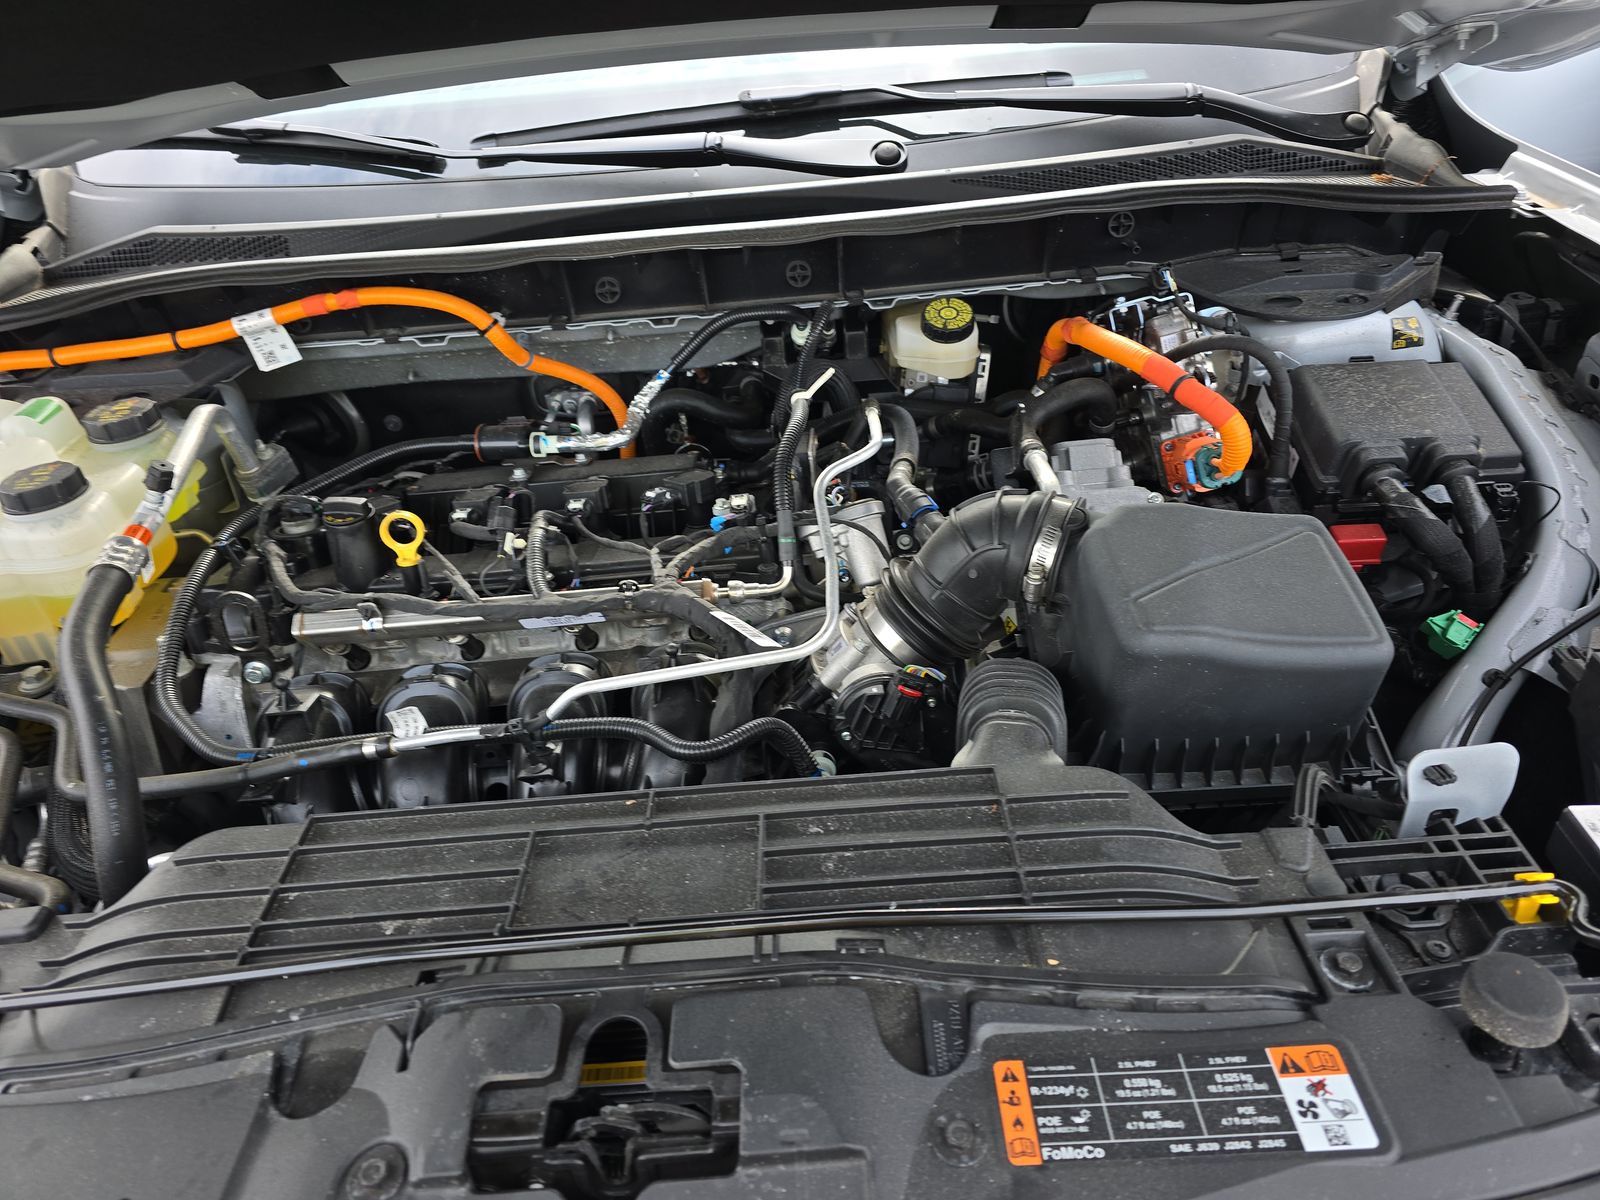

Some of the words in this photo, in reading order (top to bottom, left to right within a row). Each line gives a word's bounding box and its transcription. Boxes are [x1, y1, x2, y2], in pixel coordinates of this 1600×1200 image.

[1142, 1109, 1163, 1119] POE
[1236, 1106, 1257, 1115] POE
[1036, 1116, 1064, 1126] POE
[1041, 1145, 1106, 1161] FoMoCo
[1169, 1143, 1194, 1153] SAE
